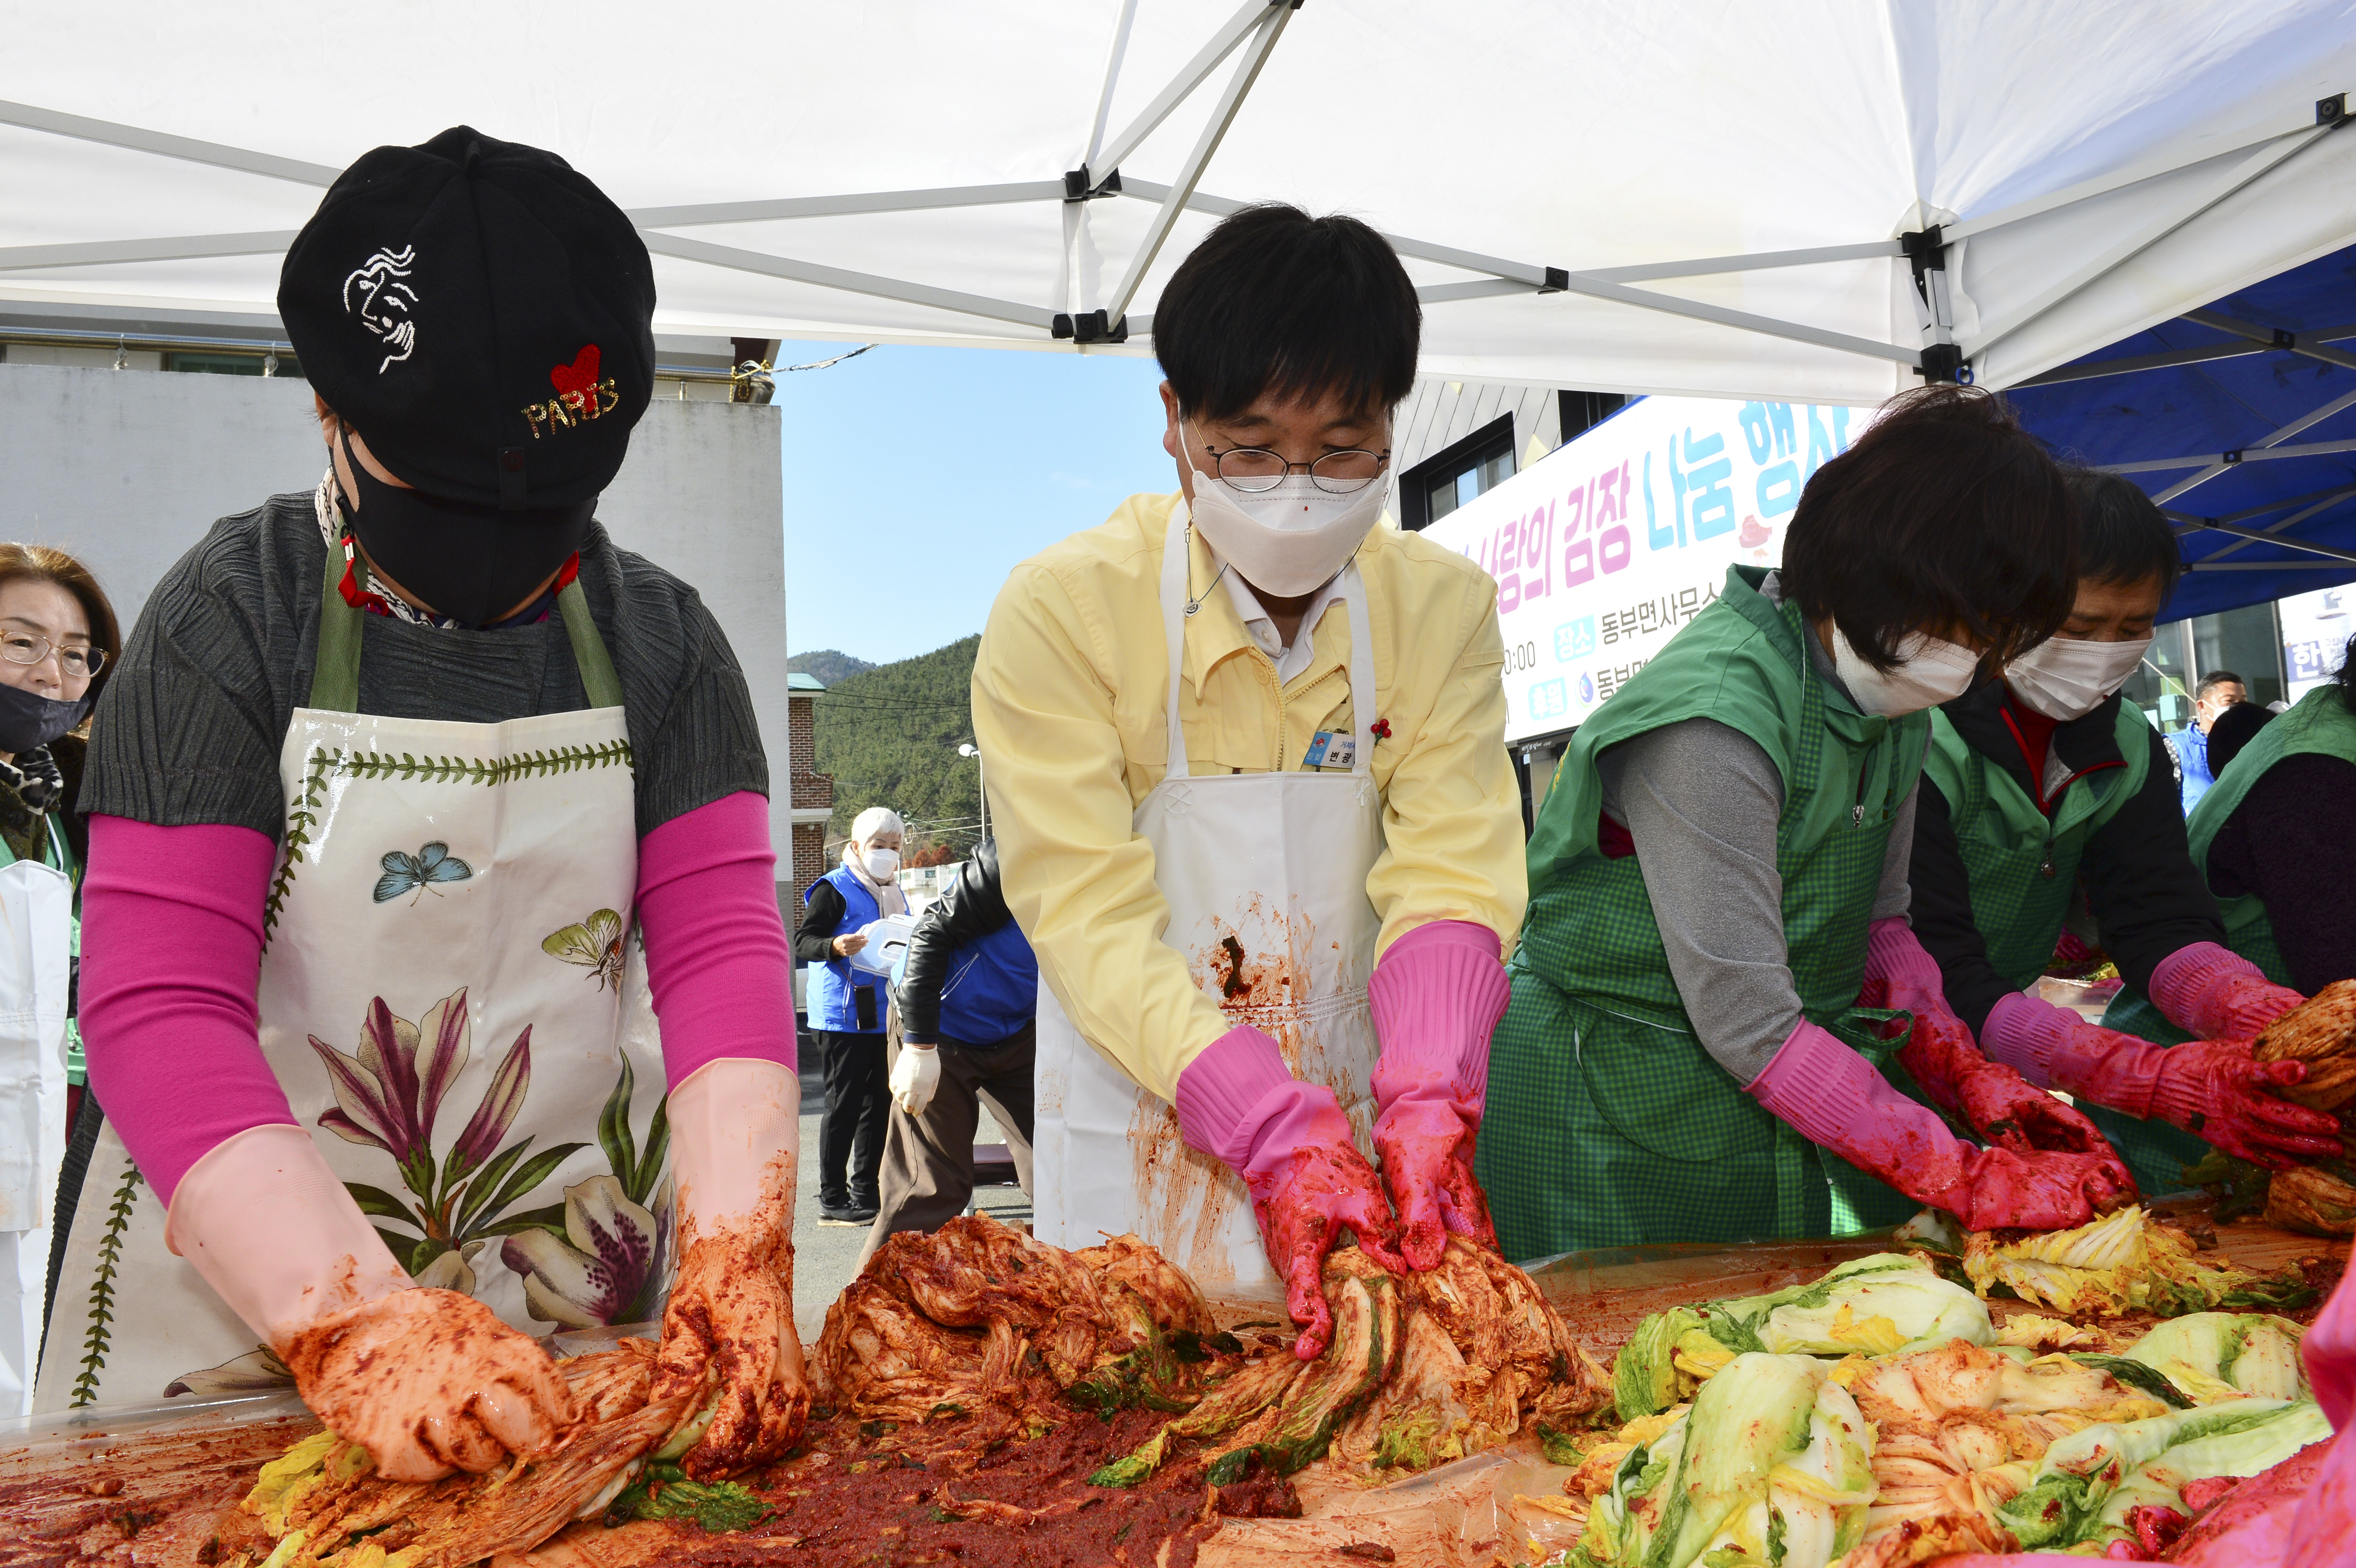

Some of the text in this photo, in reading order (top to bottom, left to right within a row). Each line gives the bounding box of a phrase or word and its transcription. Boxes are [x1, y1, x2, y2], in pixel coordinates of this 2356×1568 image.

[521, 377, 619, 438] PARIS
[1564, 458, 1631, 588] 김장
[1643, 426, 1736, 552] 나눔
[1557, 622, 1593, 660] 장소
[2292, 642, 2320, 679] 한
[1532, 682, 1564, 718] 후원
[1330, 751, 1355, 764] 변광
